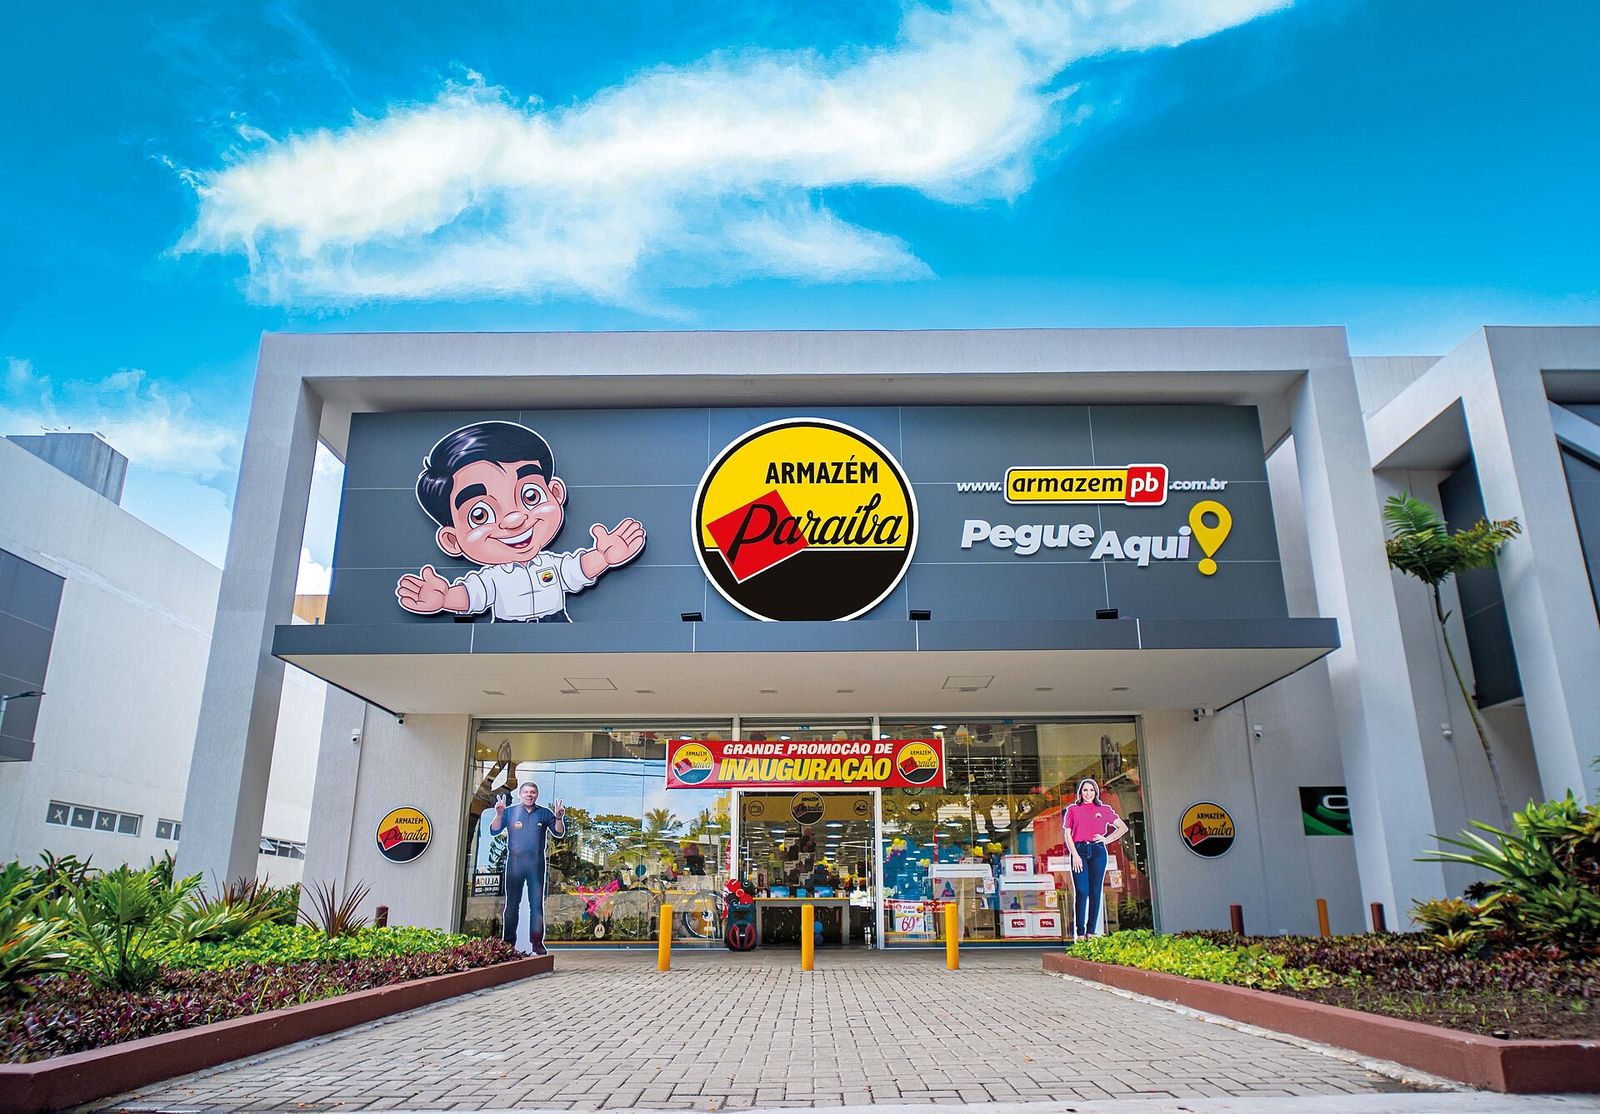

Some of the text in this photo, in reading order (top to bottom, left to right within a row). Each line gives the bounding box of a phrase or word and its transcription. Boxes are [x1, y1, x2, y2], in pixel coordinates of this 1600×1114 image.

[765, 455, 878, 484] ARMAZÉM
[961, 519, 1192, 567] Pegue Aqui
[723, 742, 893, 756] GRANDE PROMOÇÃO DE
[717, 755, 893, 783] INAUGURAÇÃO
